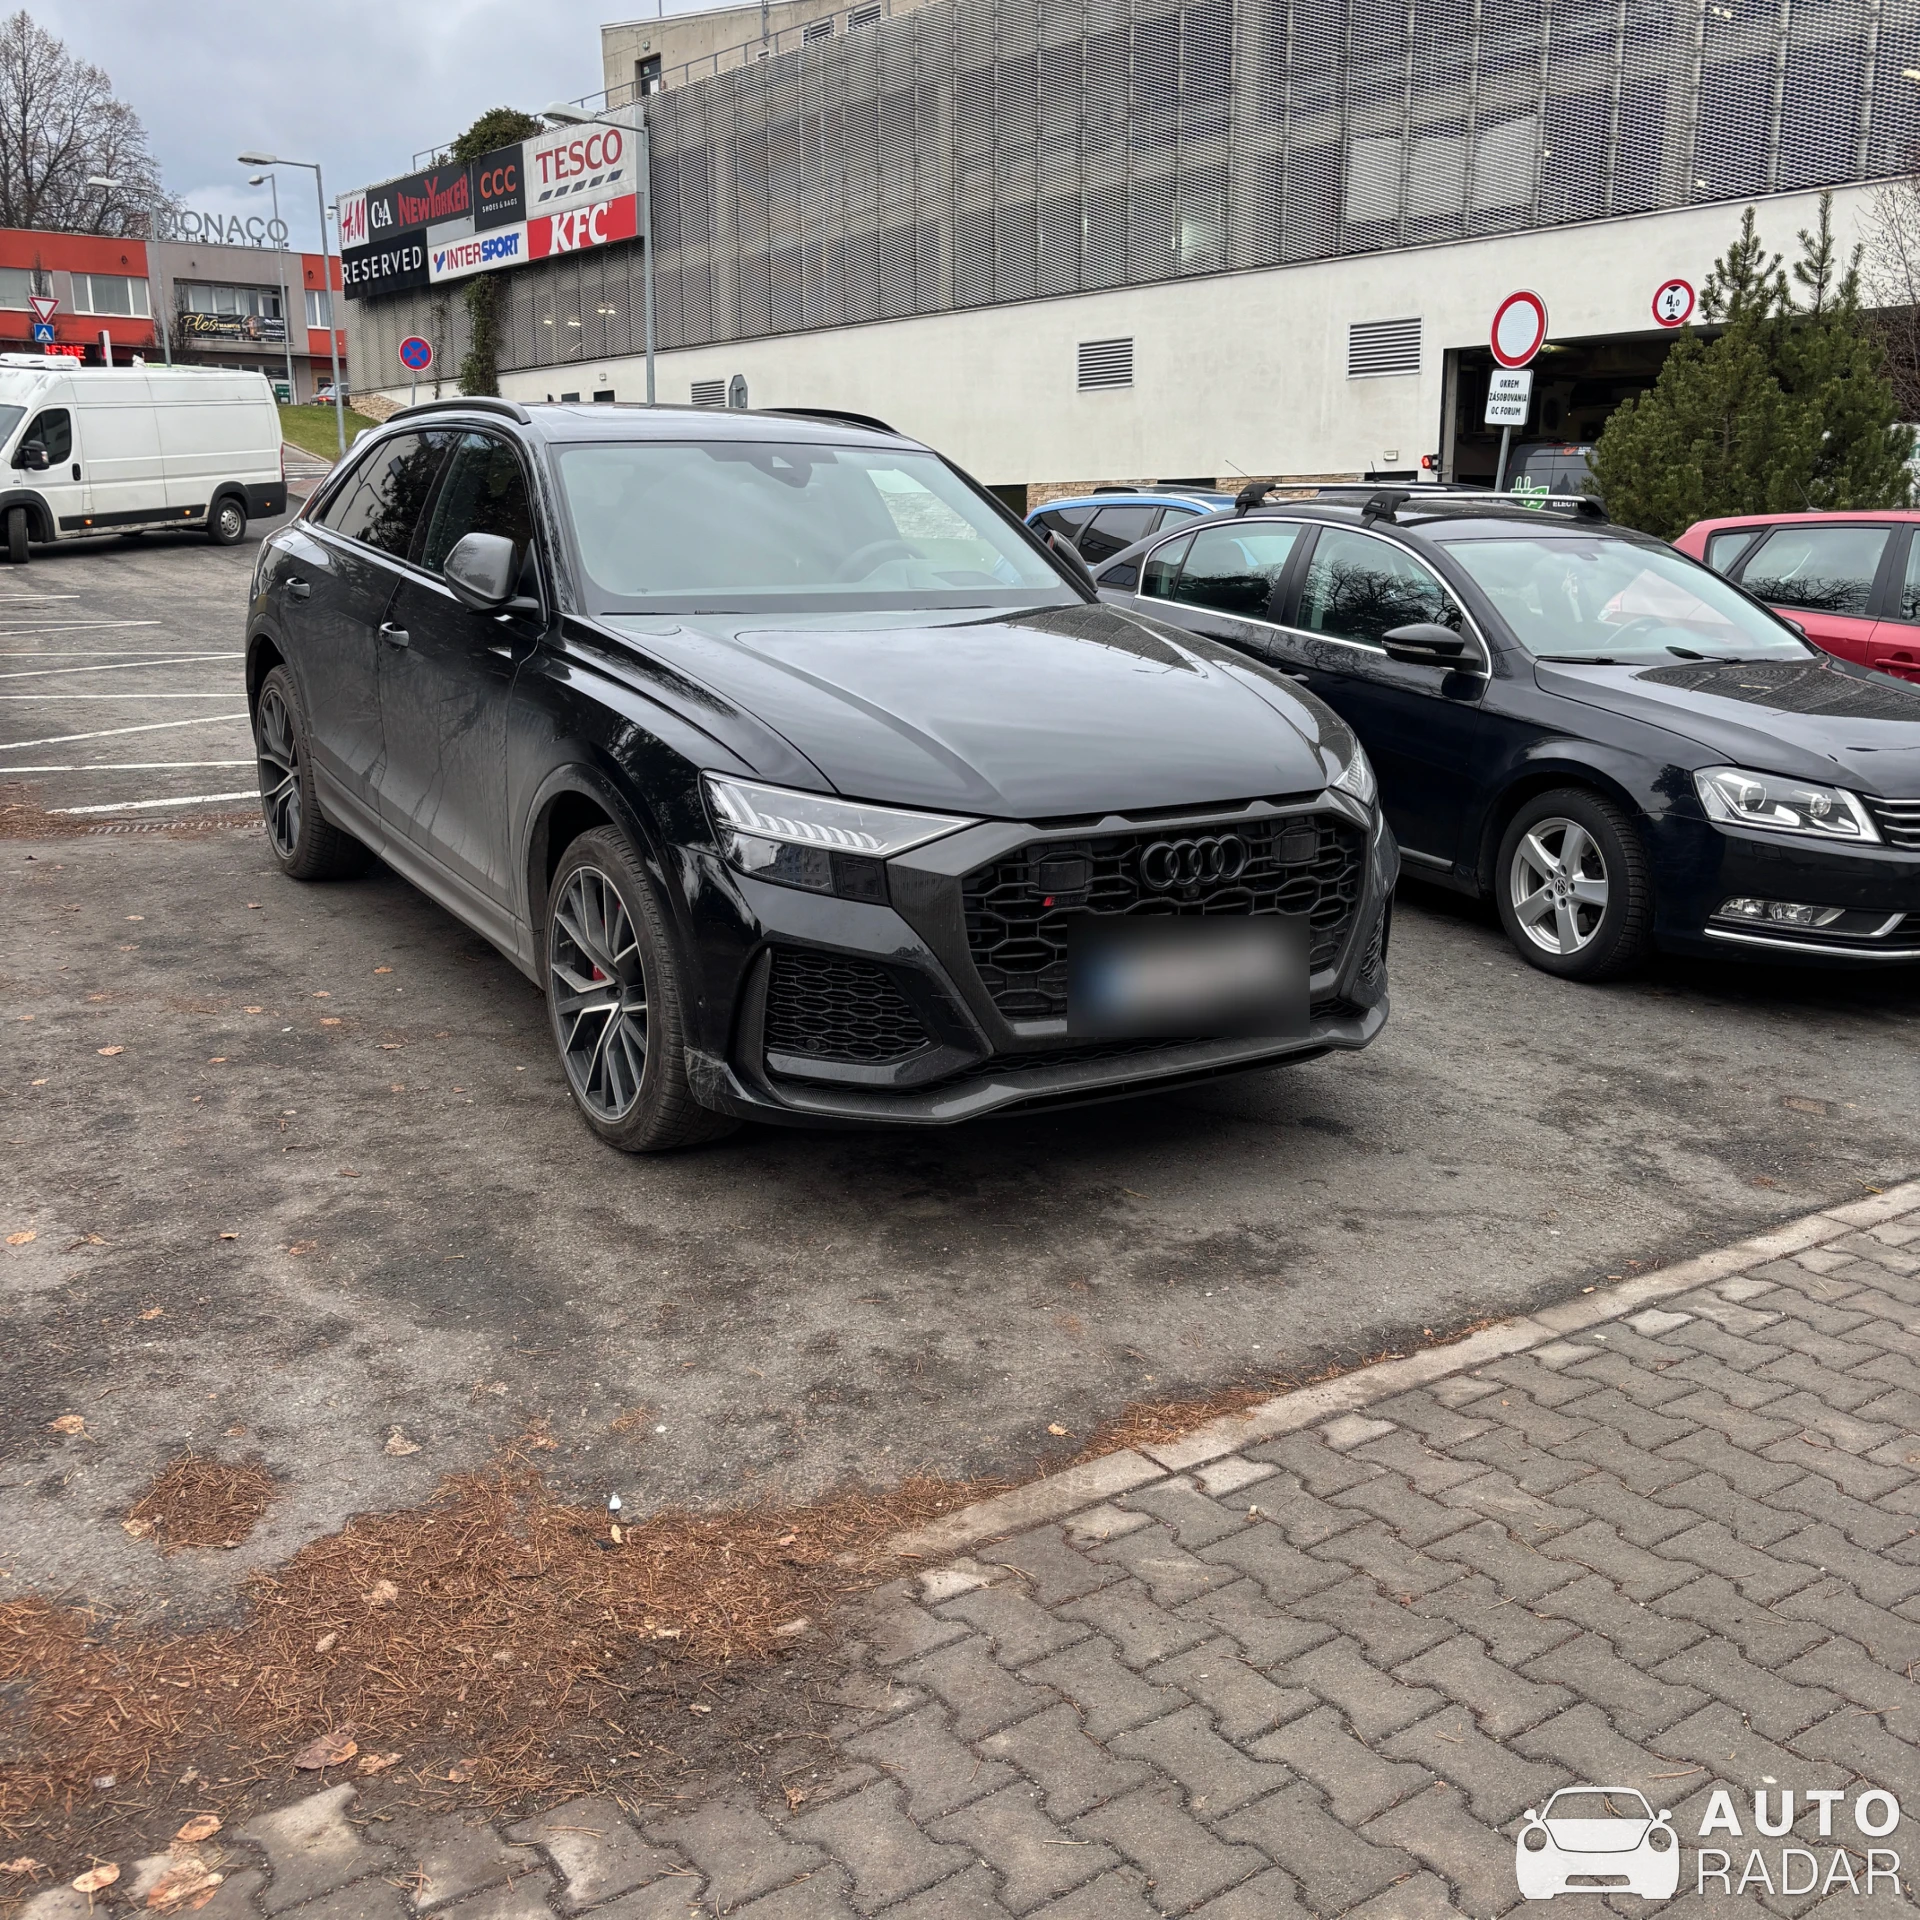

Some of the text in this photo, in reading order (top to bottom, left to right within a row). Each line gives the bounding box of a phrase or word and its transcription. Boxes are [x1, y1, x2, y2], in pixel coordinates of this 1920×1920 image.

[535, 128, 623, 184] TESCO
[480, 164, 517, 199] CCC
[341, 197, 366, 244] H&M
[370, 198, 394, 229] C&A
[481, 197, 518, 213] SHOES & BAGS
[549, 202, 609, 255] KFC
[342, 245, 422, 285] RESERVED
[446, 232, 520, 270] INTERSPORT
[183, 313, 219, 332] Ples
[1488, 390, 1527, 402] ZÁSOBOVANIA
[1500, 379, 1520, 389] OKREM
[1491, 406, 1521, 416] OC FORUM
